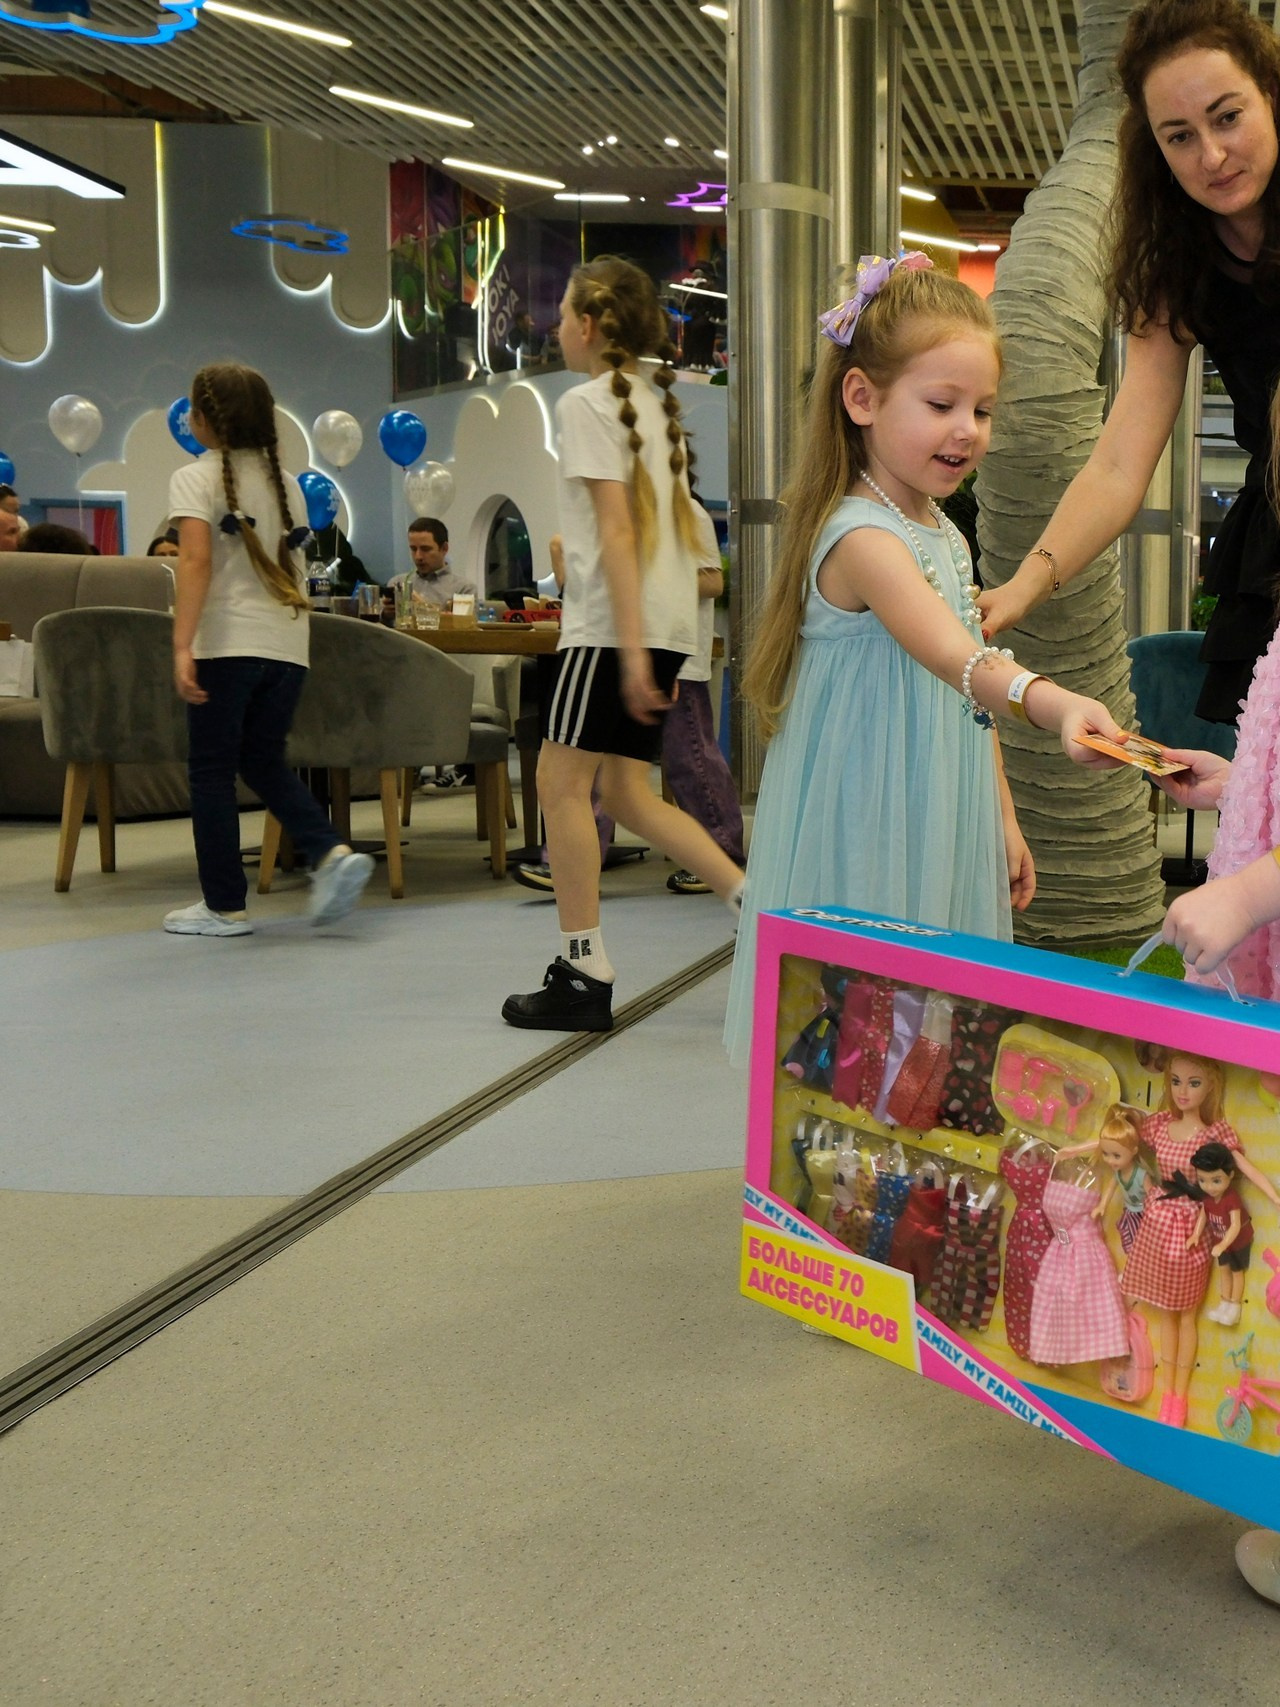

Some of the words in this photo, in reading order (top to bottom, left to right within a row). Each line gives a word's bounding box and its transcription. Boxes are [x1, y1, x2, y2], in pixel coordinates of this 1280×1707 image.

[488, 263, 511, 318] OKI
[763, 1201, 784, 1222] MY
[748, 1236, 835, 1288] БОЛЬШЕ
[838, 1267, 865, 1298] 70
[747, 1266, 899, 1345] АКСЕССУАРОВ
[916, 1319, 963, 1365] FAMILY
[963, 1358, 988, 1383] MY
[986, 1377, 1039, 1425] FAMILY
